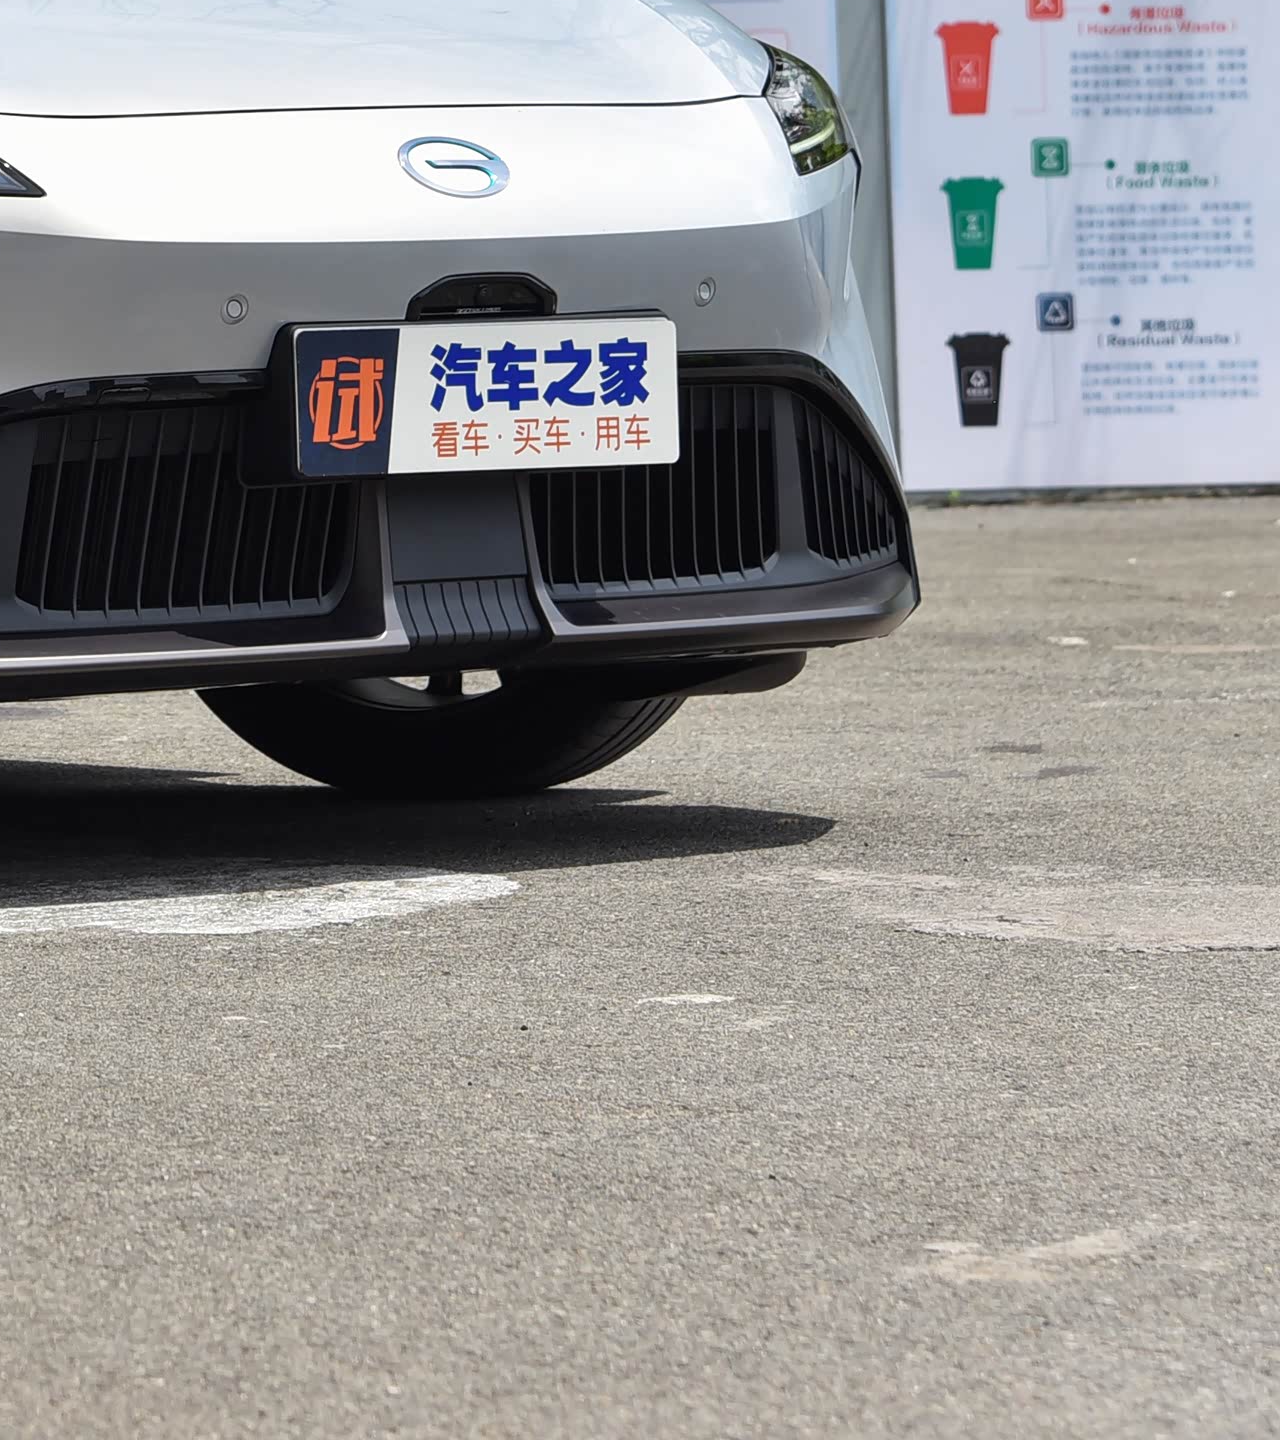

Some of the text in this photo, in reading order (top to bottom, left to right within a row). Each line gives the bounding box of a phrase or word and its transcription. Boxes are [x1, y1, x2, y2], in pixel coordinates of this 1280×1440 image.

[312, 358, 384, 443] 试
[430, 338, 649, 412] 汽车之家
